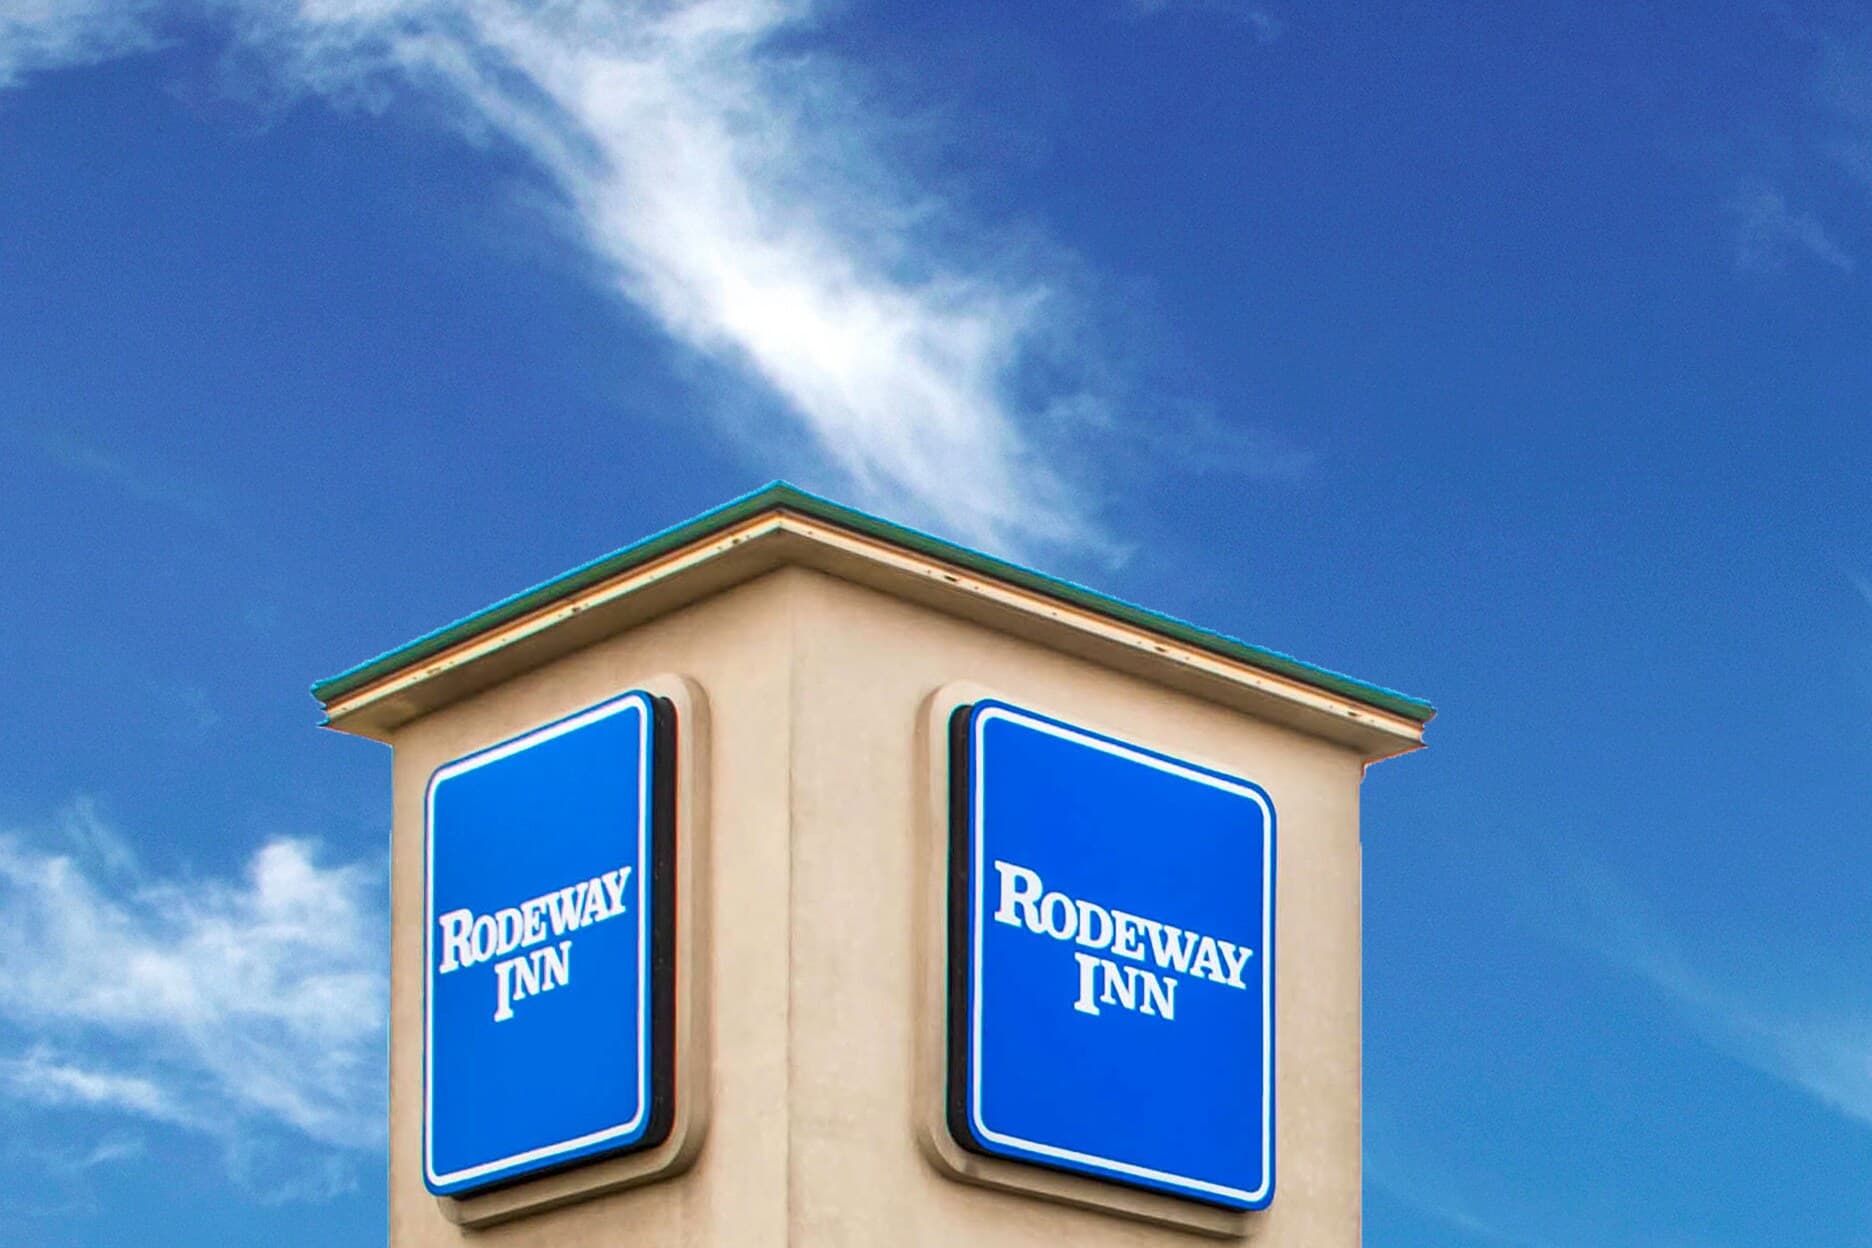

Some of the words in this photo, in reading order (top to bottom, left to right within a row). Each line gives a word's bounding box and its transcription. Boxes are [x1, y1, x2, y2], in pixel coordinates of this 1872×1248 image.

[439, 867, 630, 973] RODEWAY
[995, 861, 1252, 988] RODEWAY
[495, 941, 571, 1021] INN
[1075, 953, 1177, 1019] INN
